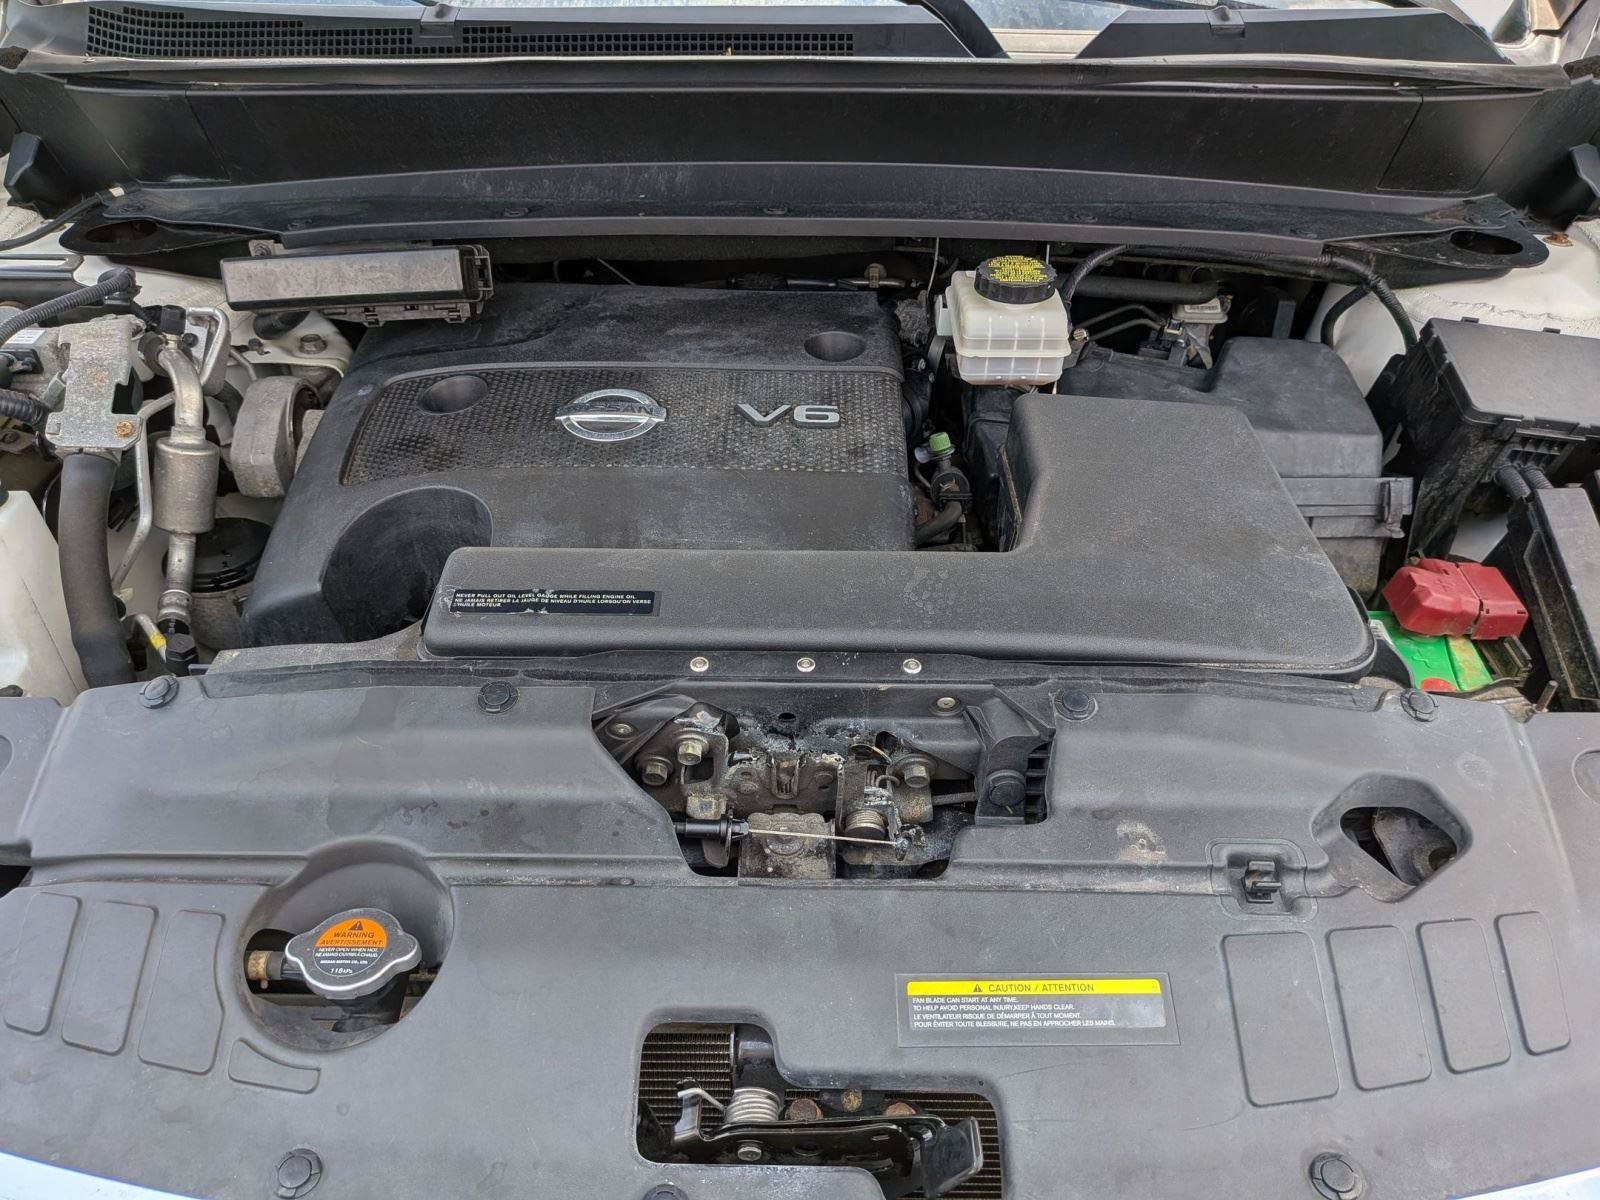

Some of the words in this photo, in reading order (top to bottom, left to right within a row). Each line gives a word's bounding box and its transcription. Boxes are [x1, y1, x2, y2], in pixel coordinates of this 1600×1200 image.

[735, 403, 841, 427] V6
[988, 984, 1031, 992] CAUTION
[1042, 983, 1094, 992] ATTENTION
